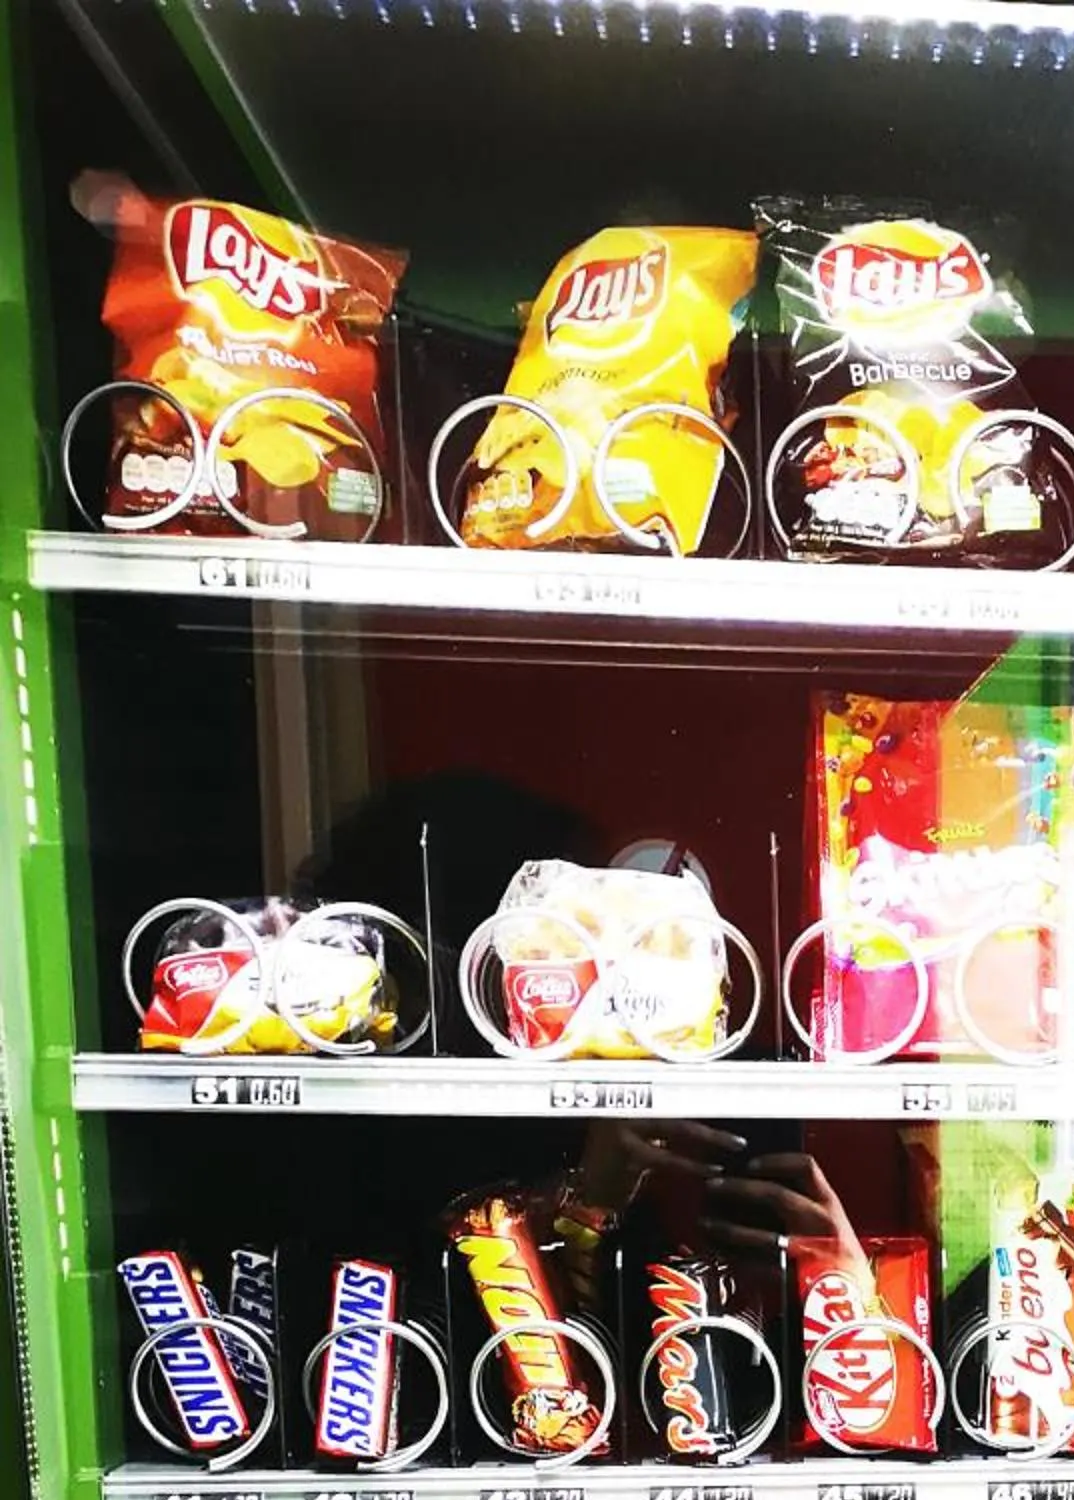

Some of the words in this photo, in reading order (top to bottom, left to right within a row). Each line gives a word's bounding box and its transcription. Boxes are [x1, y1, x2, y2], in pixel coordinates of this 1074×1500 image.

[848, 359, 973, 388] Barbecue
[201, 558, 248, 587] 61
[194, 1077, 240, 1104] 51
[249, 1078, 299, 1104] 0.60
[118, 1259, 240, 1444] SNICKERS
[325, 1264, 388, 1447] SNICKERS
[456, 1234, 571, 1388] LION
[1011, 1247, 1052, 1376] bueno
